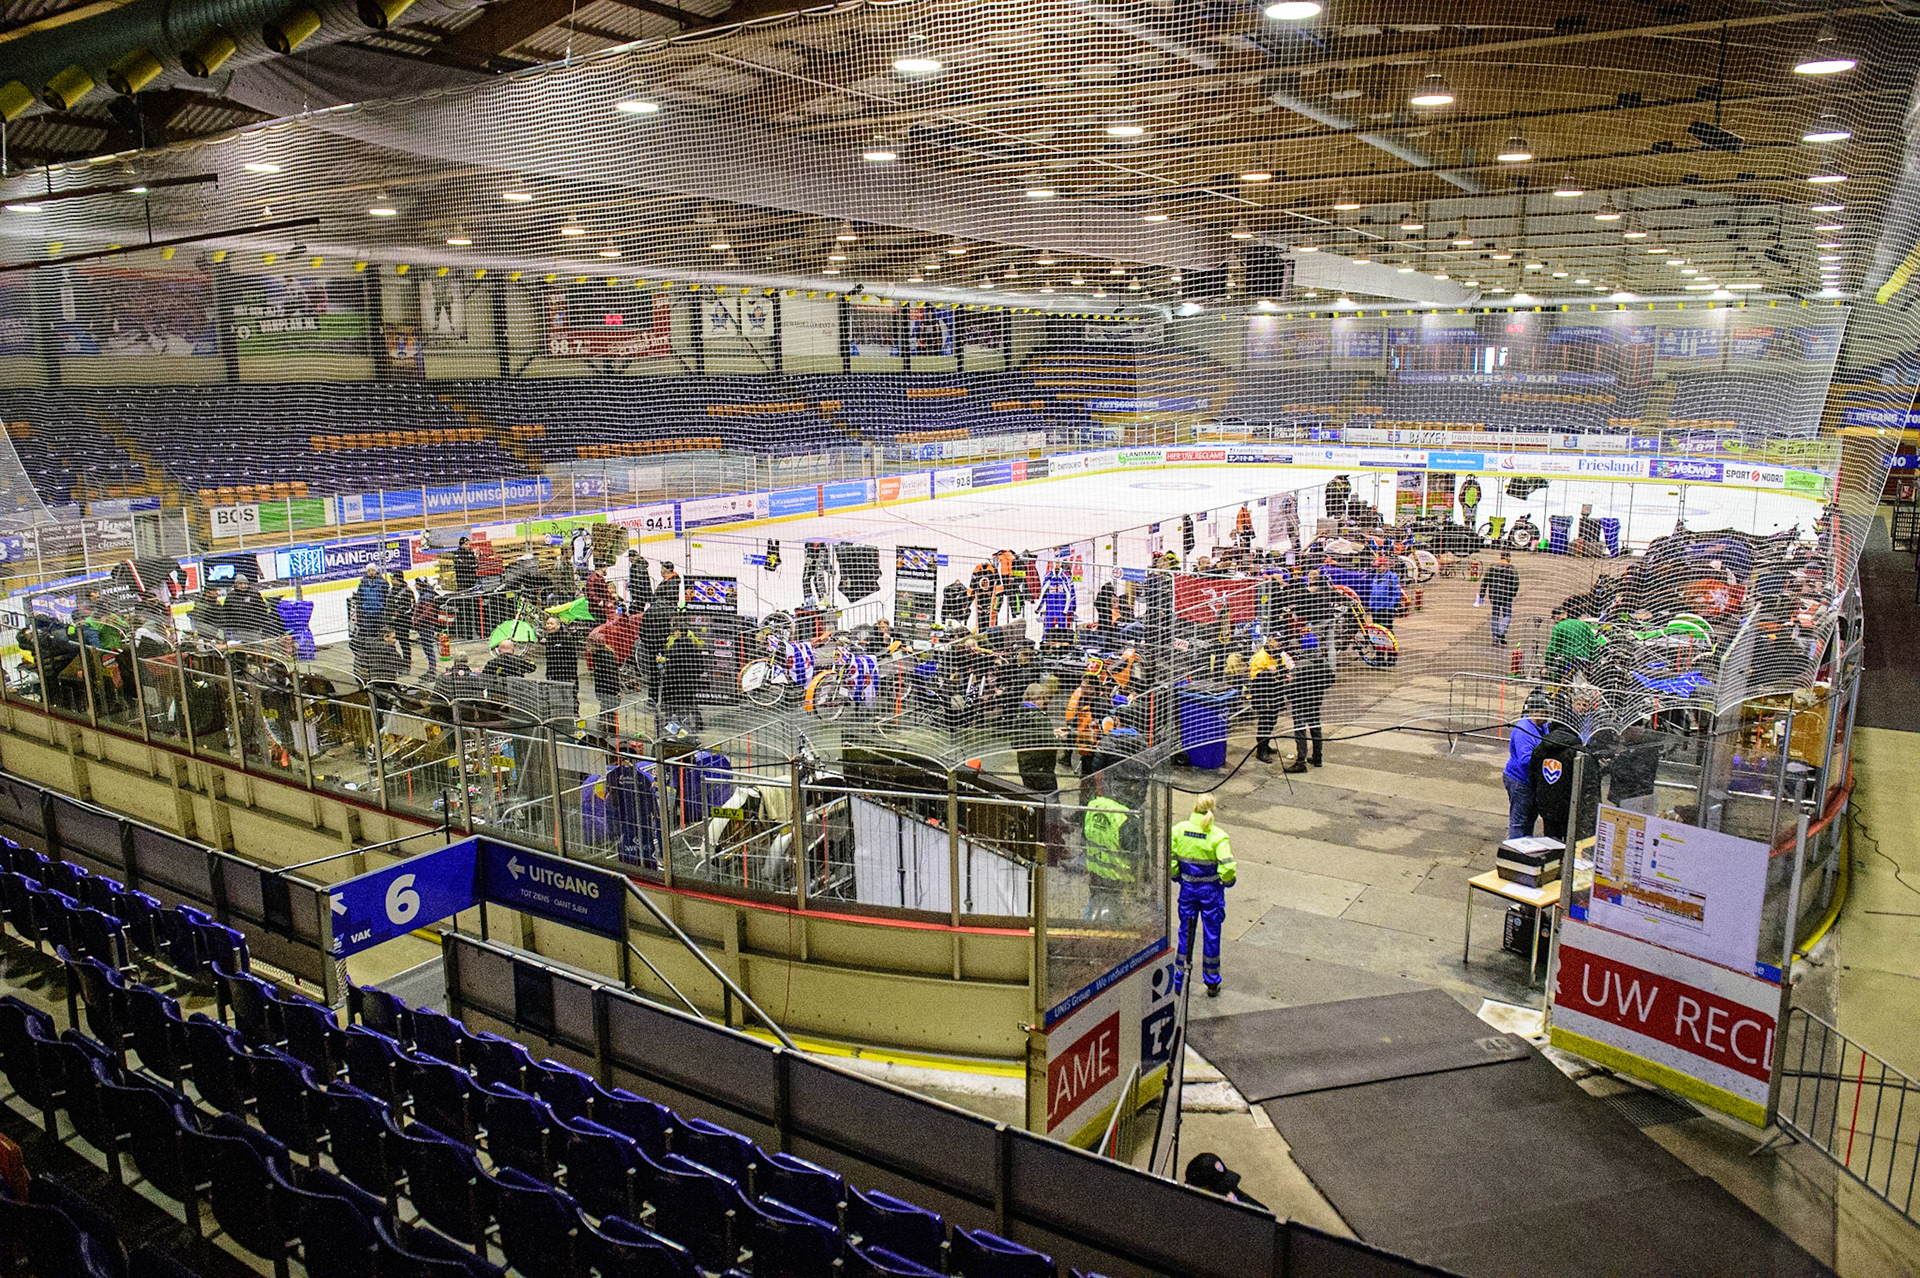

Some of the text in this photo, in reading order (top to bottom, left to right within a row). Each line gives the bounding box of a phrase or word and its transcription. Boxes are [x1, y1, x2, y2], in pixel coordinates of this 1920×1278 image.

[1450, 374, 1503, 383] FLYERS
[1526, 374, 1558, 384] BAR
[1409, 431, 1447, 445] BAKKER
[1451, 433, 1488, 444] transport
[1637, 439, 1650, 448] 12
[1125, 450, 1162, 458] LANDMAN
[1166, 452, 1181, 460] HIER
[1194, 451, 1225, 460] RECLAME
[1578, 458, 1639, 473] Friesland
[957, 475, 971, 488] 92.8
[1725, 469, 1750, 480] SPORT
[1761, 473, 1783, 483] NOORD
[217, 508, 255, 525] BOS
[646, 516, 673, 531] 94.1
[713, 808, 740, 817] D.E.V.
[529, 864, 599, 899] UITGANG
[385, 873, 421, 925] 6
[521, 888, 533, 899] TOT
[533, 890, 550, 902] ZIENS
[553, 898, 571, 910] OANT
[572, 901, 588, 915] SJEN
[350, 928, 372, 945] VAK
[1053, 1001, 1071, 1018] UNIS
[1071, 989, 1092, 1009] Group
[1095, 979, 1108, 991] We
[1107, 965, 1130, 987] reduce
[1581, 962, 1659, 1023] UW
[1047, 1029, 1111, 1121] AME
